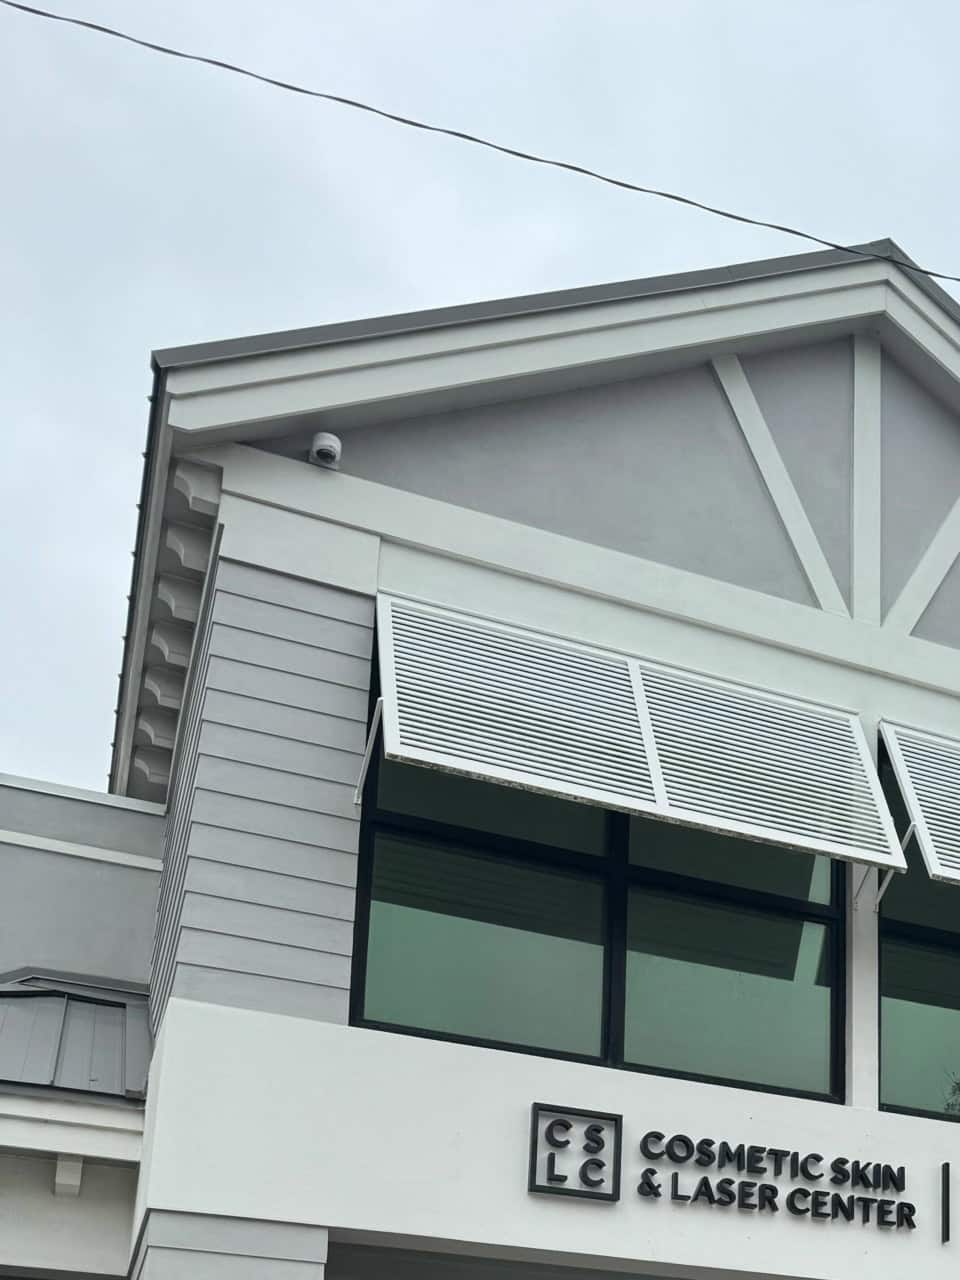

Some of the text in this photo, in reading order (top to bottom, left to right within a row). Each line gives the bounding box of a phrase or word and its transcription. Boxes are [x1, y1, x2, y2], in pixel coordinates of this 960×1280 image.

[640, 1131, 906, 1192] COSMETIC SKIN
[637, 1167, 917, 1230] & LASER CENTER
